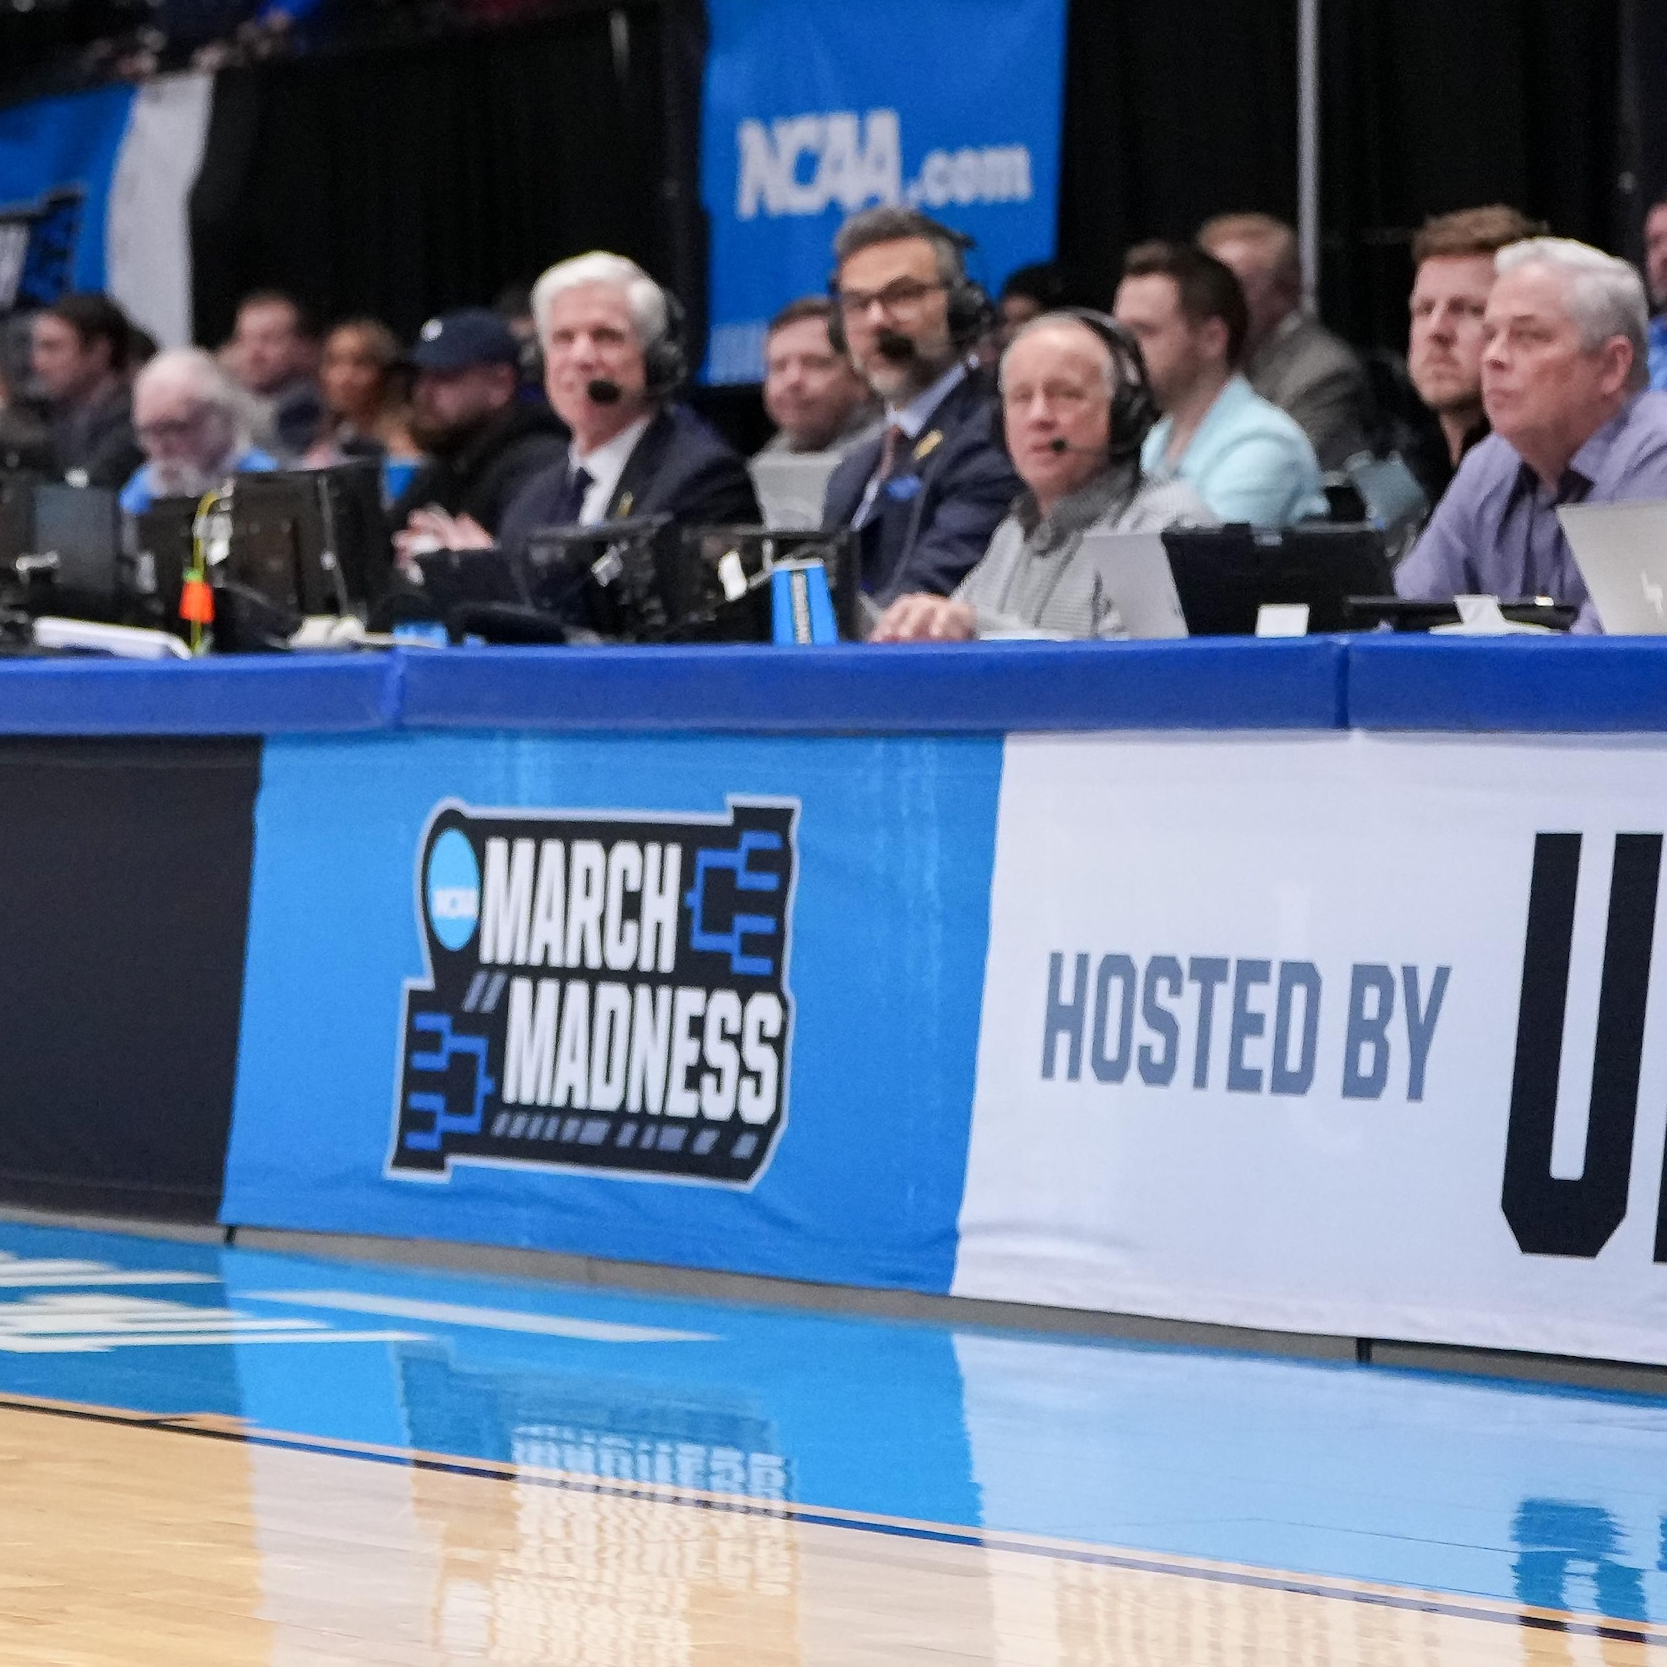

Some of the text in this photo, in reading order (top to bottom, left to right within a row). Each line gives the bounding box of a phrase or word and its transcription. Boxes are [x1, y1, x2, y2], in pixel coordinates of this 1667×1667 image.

[734, 107, 1034, 222] NCAA.com
[478, 836, 682, 973] MARCH
[501, 976, 784, 1126] MADNESS
[1039, 950, 1452, 1102] HOSTED BY
[1500, 830, 1667, 1266] U
